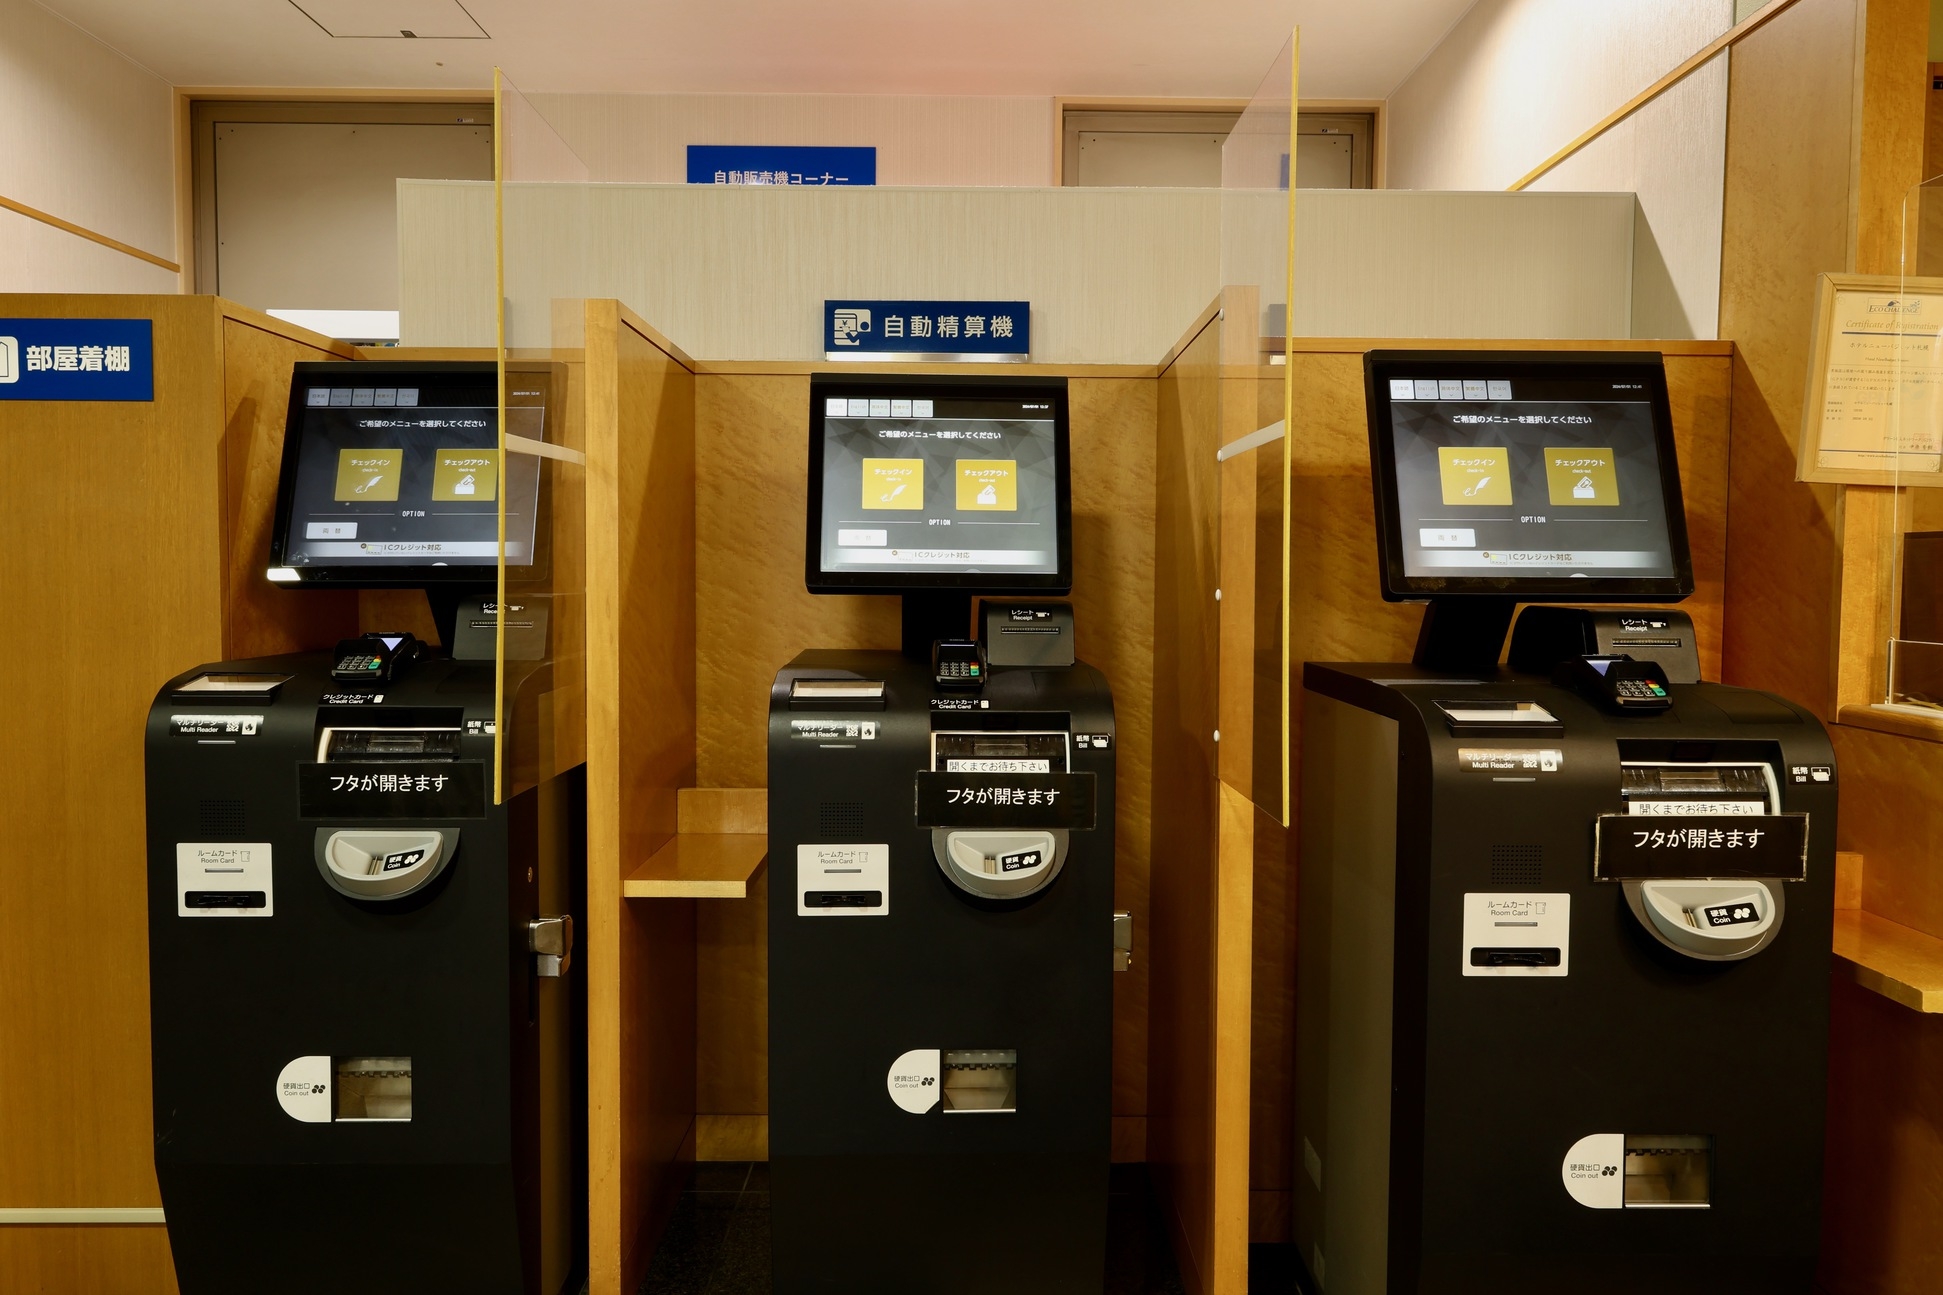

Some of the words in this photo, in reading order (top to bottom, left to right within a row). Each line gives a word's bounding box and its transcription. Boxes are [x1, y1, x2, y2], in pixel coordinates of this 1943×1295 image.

[713, 170, 849, 185] 自動販売機コーナー
[884, 315, 1014, 338] 自動精算機
[1845, 319, 1884, 331] Certificate
[1885, 320, 1896, 331] of
[26, 345, 130, 372] 部屋着棚
[359, 420, 487, 428] ご希望のメニューを選択してください
[1453, 415, 1592, 425] ご希望のメニューを選択してください
[878, 430, 1001, 440] ご希望のメニューを選択してください
[351, 459, 390, 467] チェックイン
[444, 459, 491, 467] チェックアウト
[1555, 459, 1606, 467] チェックアウト
[874, 468, 913, 476] チェックイン
[964, 469, 1009, 477] チェックアウト
[949, 761, 1048, 772] 開くまでお待ち下さい
[330, 774, 449, 792] フタが開きます
[946, 788, 1060, 805] フタが開きます
[1639, 803, 1754, 815] 開くまでお待ち下さい
[1633, 828, 1765, 849] フタが開きます
[1487, 901, 1532, 909] ルームカード
[1713, 916, 1731, 924] Coin
[283, 1082, 310, 1090] 硬貨出口
[1570, 1164, 1600, 1172] 硬貨出口
